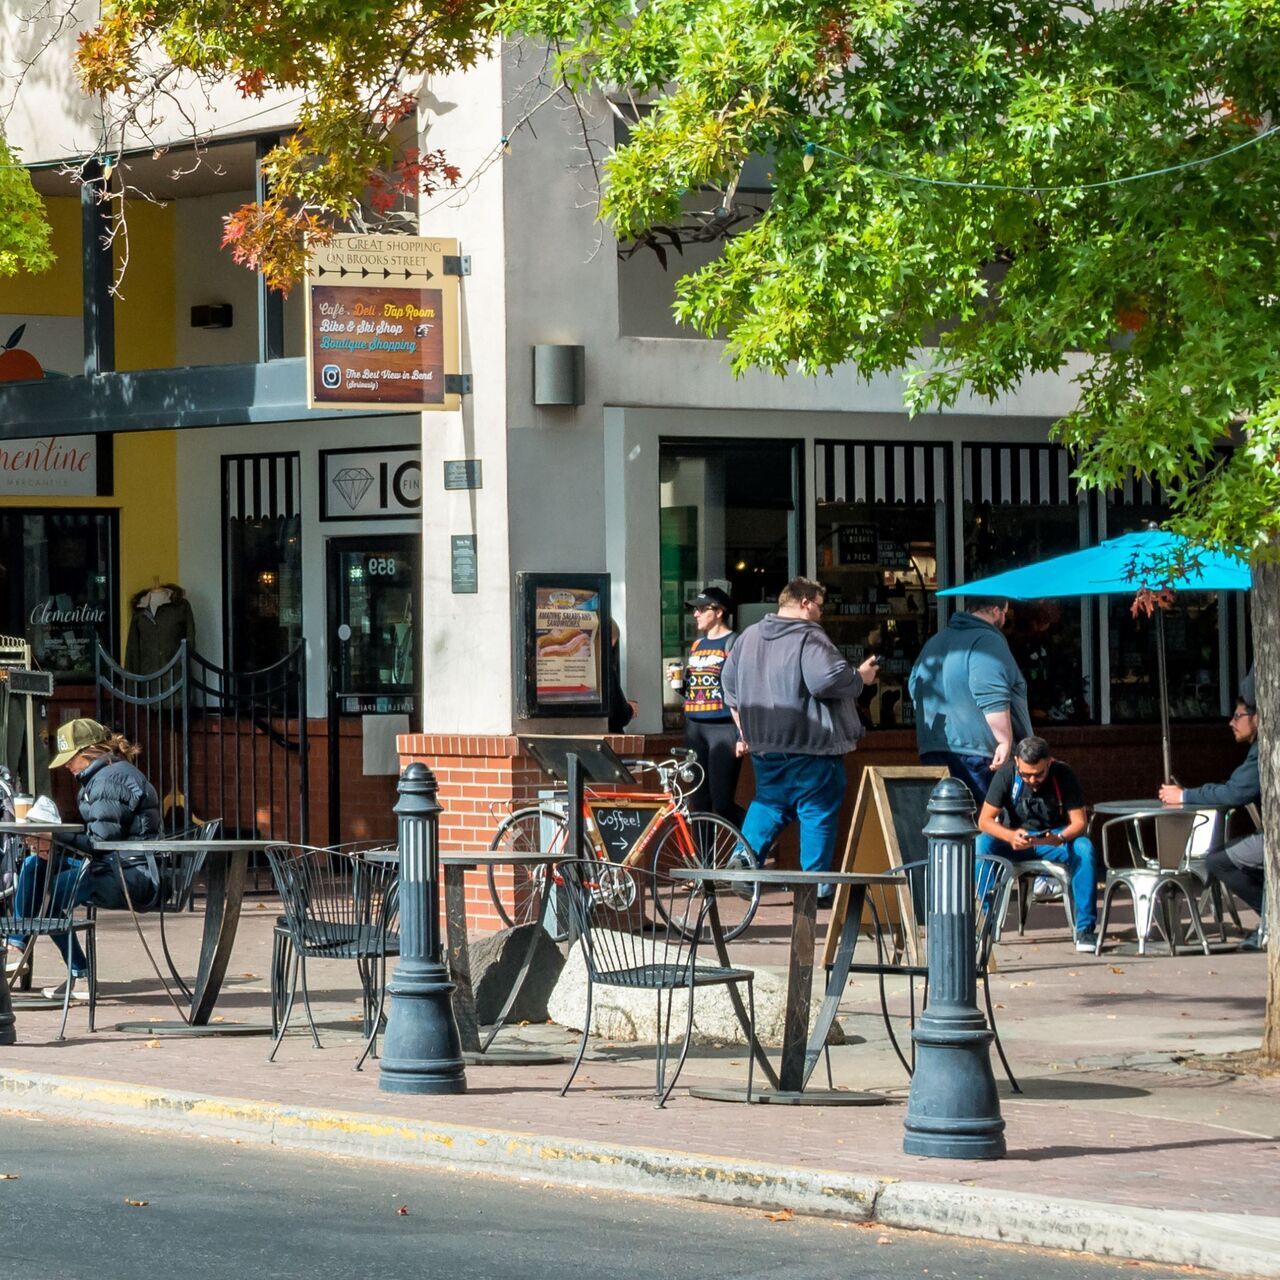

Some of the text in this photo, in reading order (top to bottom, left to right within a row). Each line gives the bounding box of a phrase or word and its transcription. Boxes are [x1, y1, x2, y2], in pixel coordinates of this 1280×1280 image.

[347, 237, 384, 250] GREAT
[386, 241, 441, 253] SHOPPING
[326, 253, 428, 266] ON BROOKS STREET
[319, 302, 435, 320] Café Deli Tap Room
[319, 318, 404, 336] Bike & Ski Shop
[319, 335, 417, 353] Boutique Shopping
[346, 368, 434, 381] The Best View in Bend
[30, 603, 107, 625] Clementine
[597, 809, 640, 832] Coffee!
